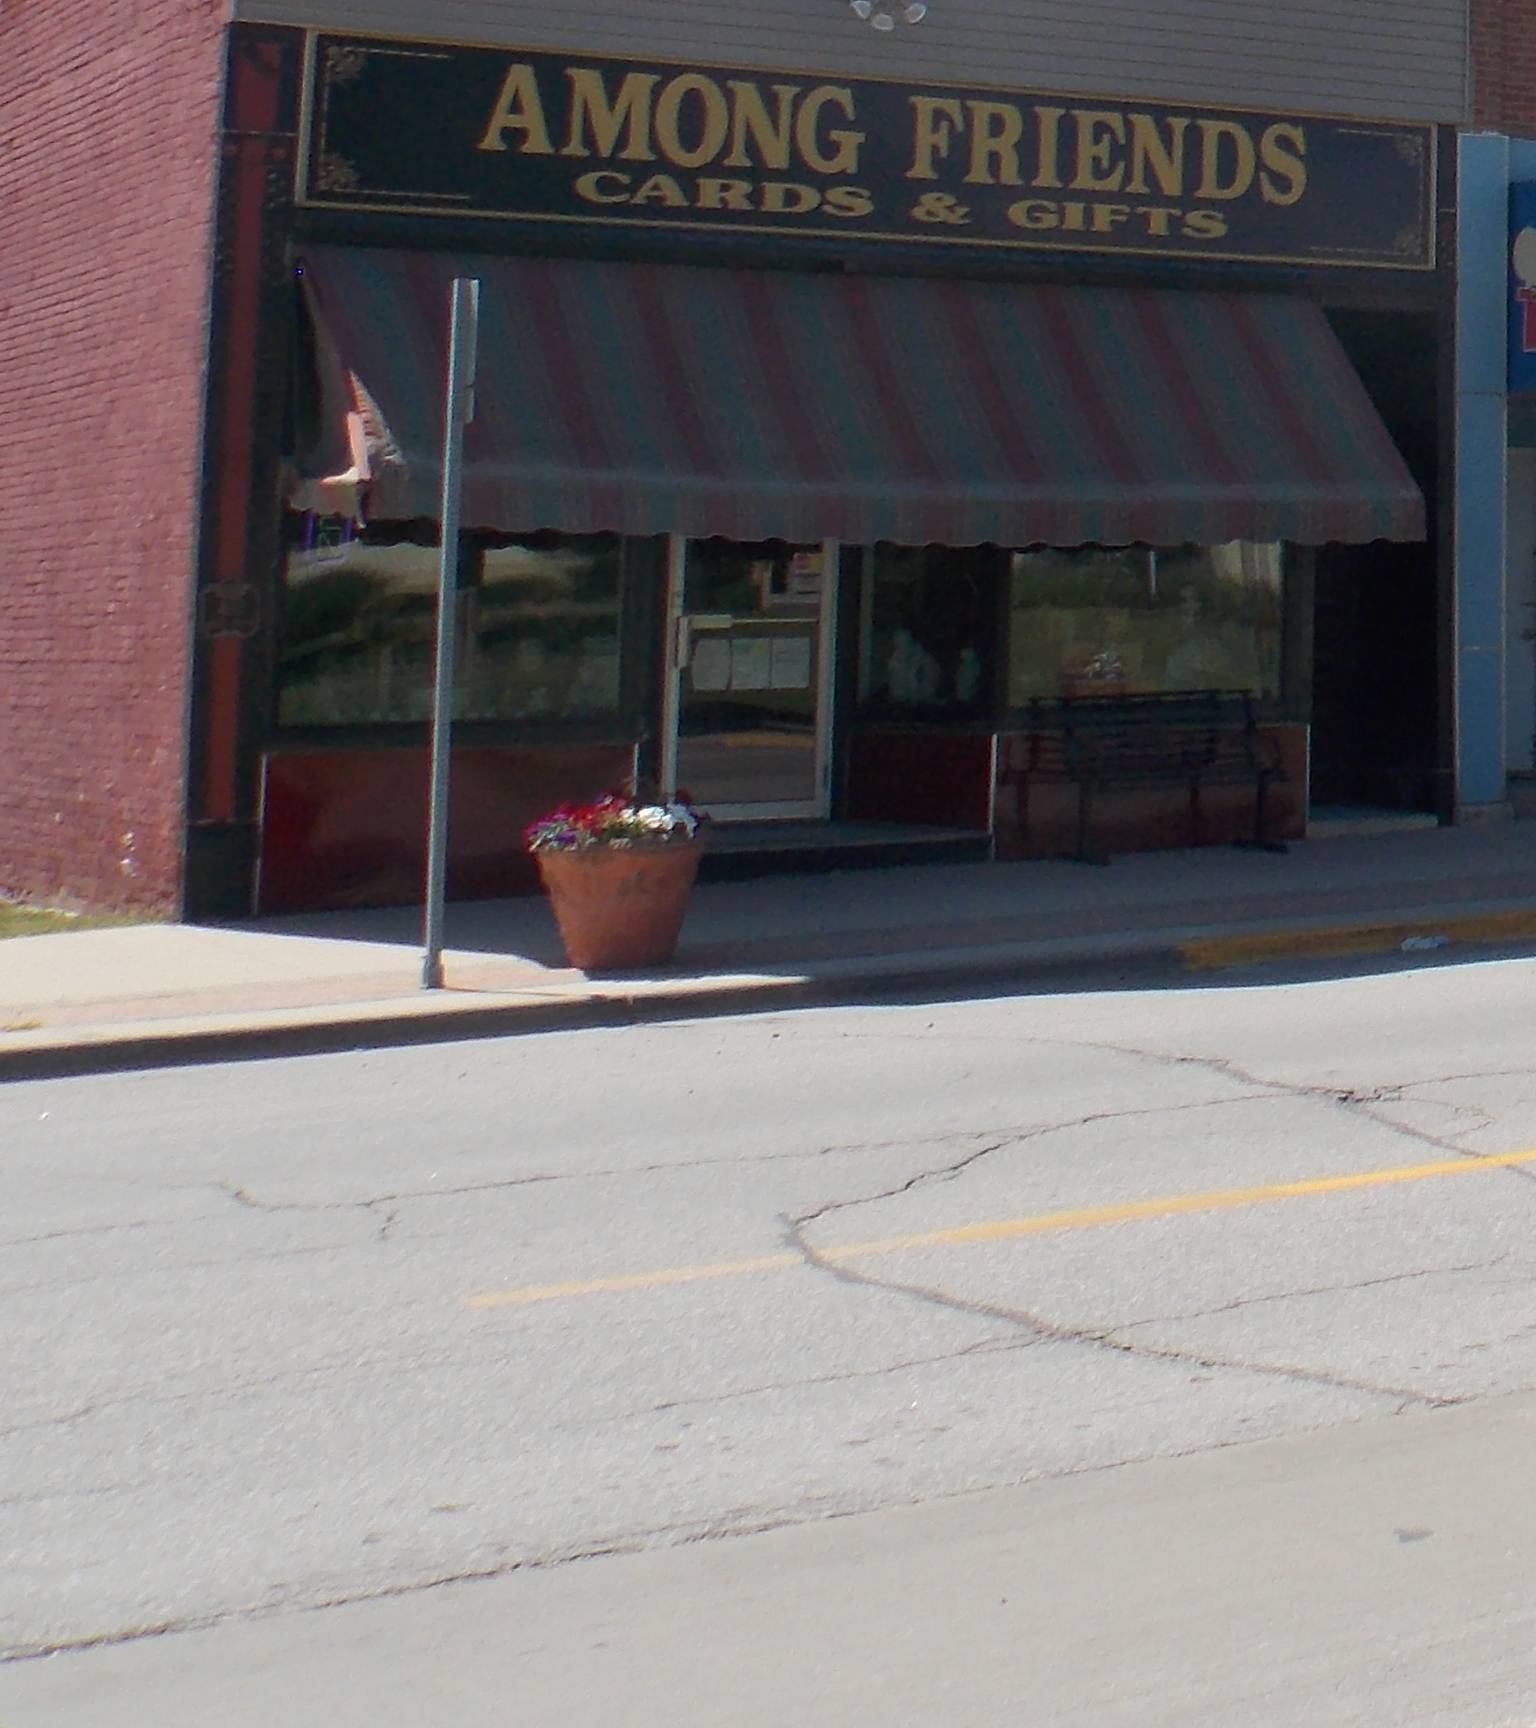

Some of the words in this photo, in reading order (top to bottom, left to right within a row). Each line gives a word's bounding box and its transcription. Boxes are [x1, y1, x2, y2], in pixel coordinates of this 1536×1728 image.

[475, 63, 867, 174] AMONG
[905, 95, 1308, 206] FRIENDS
[572, 171, 875, 218] CARDS
[909, 191, 953, 226] &
[1006, 198, 1229, 239] GIFTS
